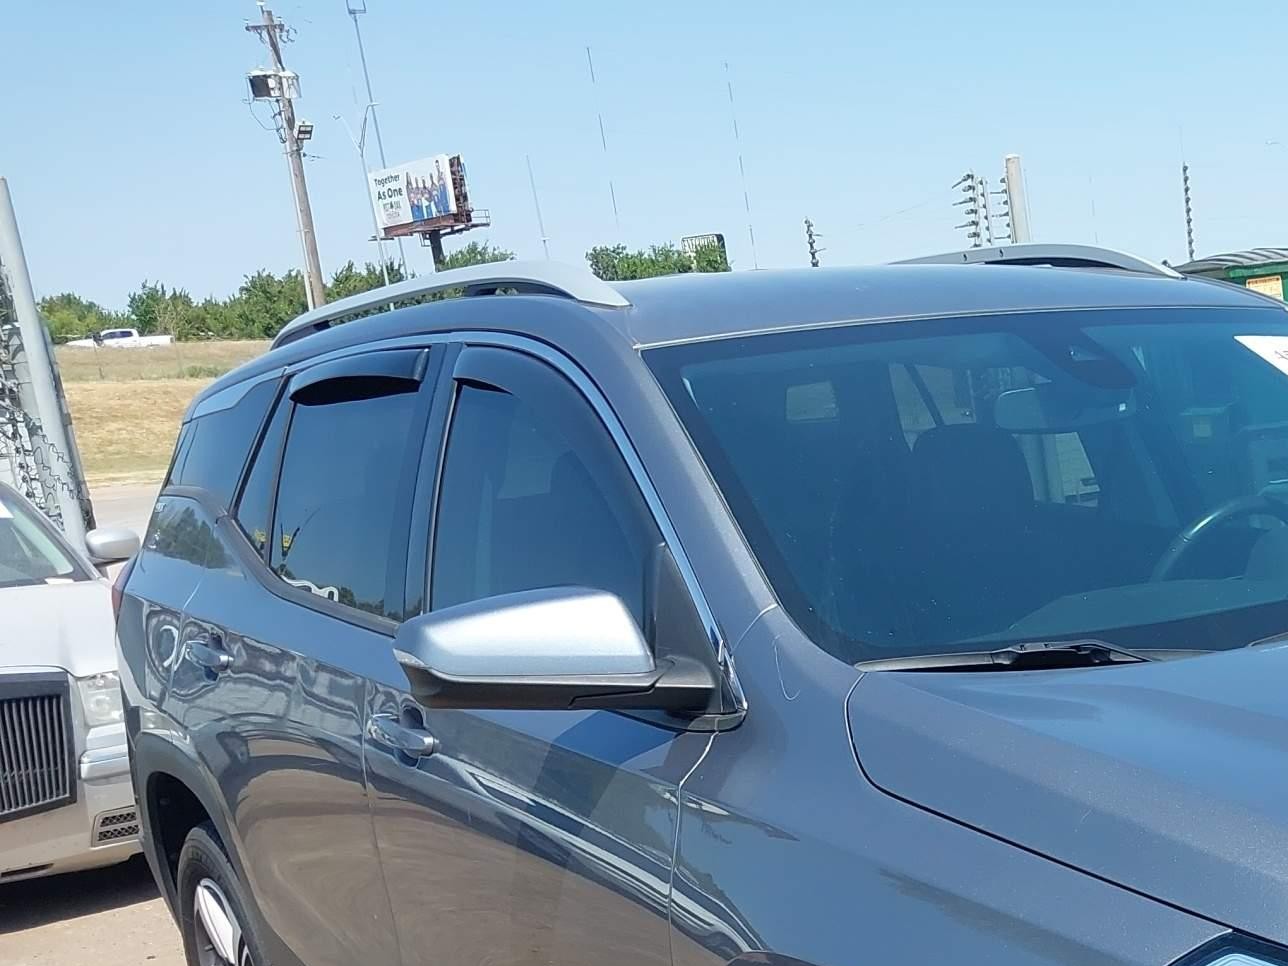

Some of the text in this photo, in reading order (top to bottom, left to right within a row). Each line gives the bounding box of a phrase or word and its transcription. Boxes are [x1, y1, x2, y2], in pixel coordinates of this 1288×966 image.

[374, 175, 400, 187] Together
[377, 187, 403, 200] As One
